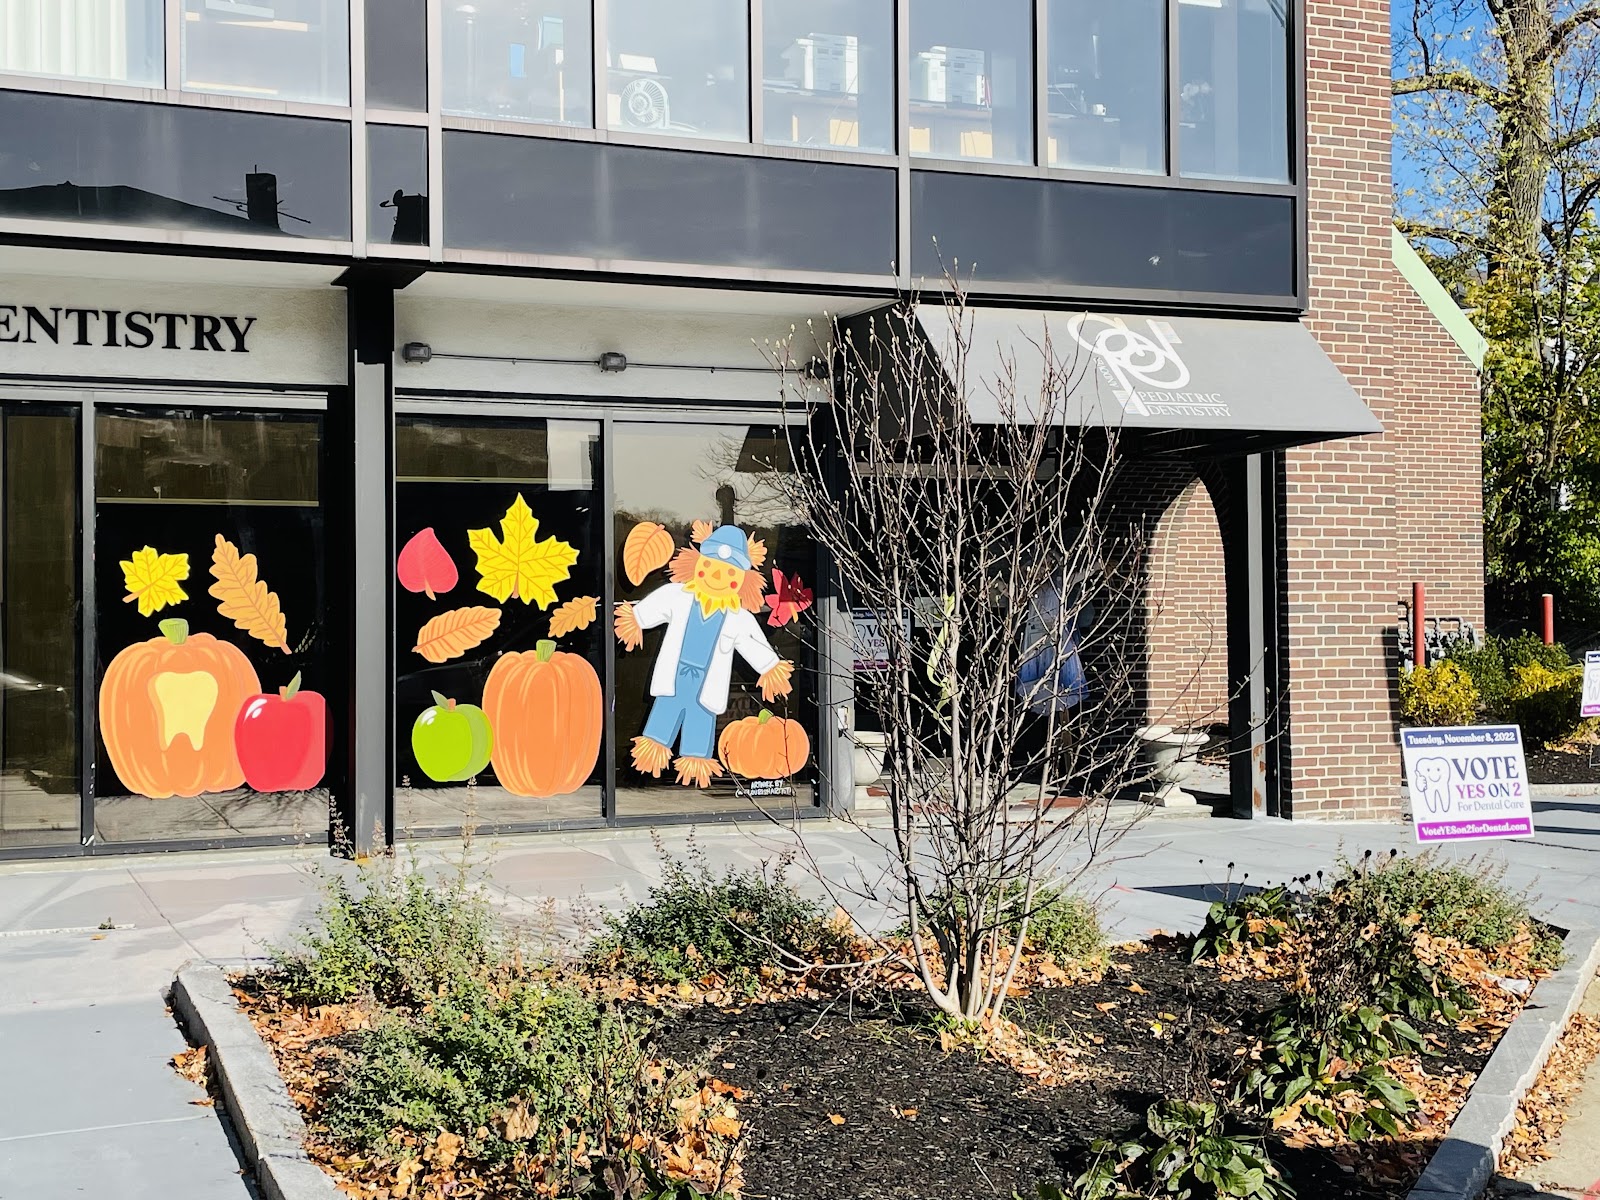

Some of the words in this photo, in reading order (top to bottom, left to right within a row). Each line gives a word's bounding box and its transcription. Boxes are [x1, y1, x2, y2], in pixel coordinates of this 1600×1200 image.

[0, 305, 257, 353] ENTISTRY
[1138, 390, 1225, 404] PEDIATRIC
[1149, 405, 1232, 417] DENTISTRY
[867, 639, 885, 647] YES
[1407, 734, 1445, 746] Tuesday,
[1444, 733, 1485, 744] November
[1485, 732, 1494, 743] 8,
[1494, 732, 1515, 742] 2022
[1451, 756, 1519, 780] VOTE
[1456, 784, 1486, 799] YES
[1488, 783, 1510, 797] ON
[1512, 782, 1522, 796] 2
[1457, 802, 1473, 812] For
[1474, 800, 1503, 811] Dental
[1504, 800, 1524, 809] Care
[1422, 822, 1528, 836] VoteYESon2forDental.com
